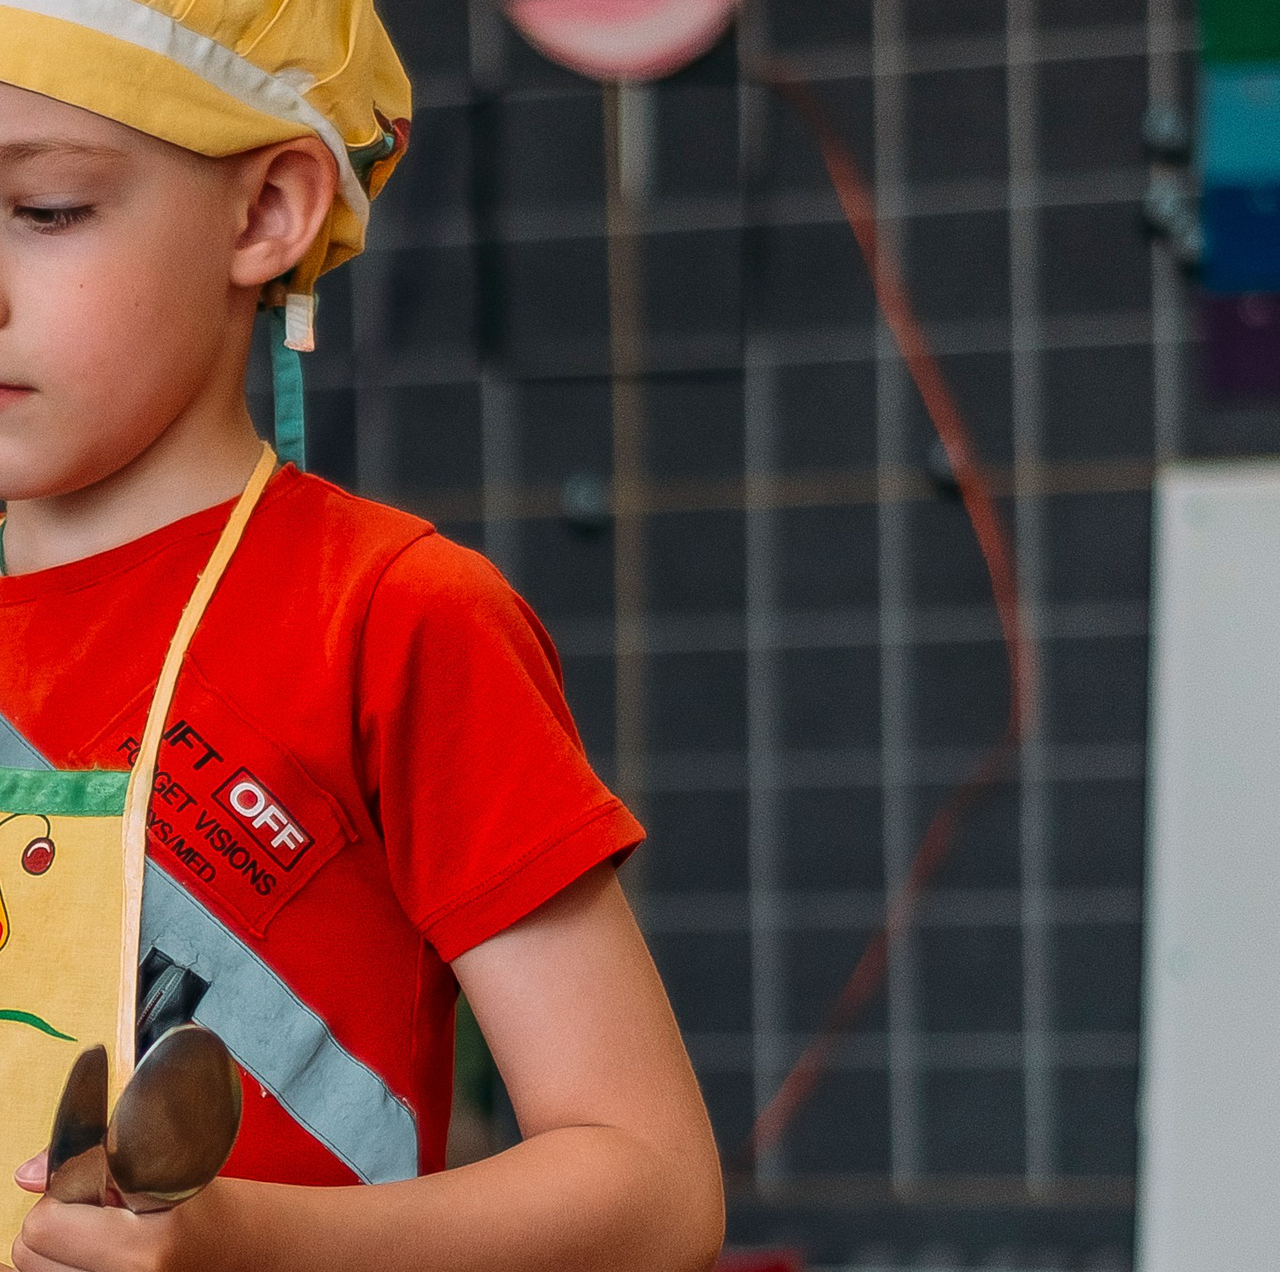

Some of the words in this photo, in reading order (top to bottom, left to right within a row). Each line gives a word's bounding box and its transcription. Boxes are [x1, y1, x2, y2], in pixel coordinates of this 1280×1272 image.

[116, 736, 198, 813] FOGET
[194, 809, 277, 896] VISIONS
[162, 719, 224, 771] IFT
[229, 782, 305, 850] OFF
